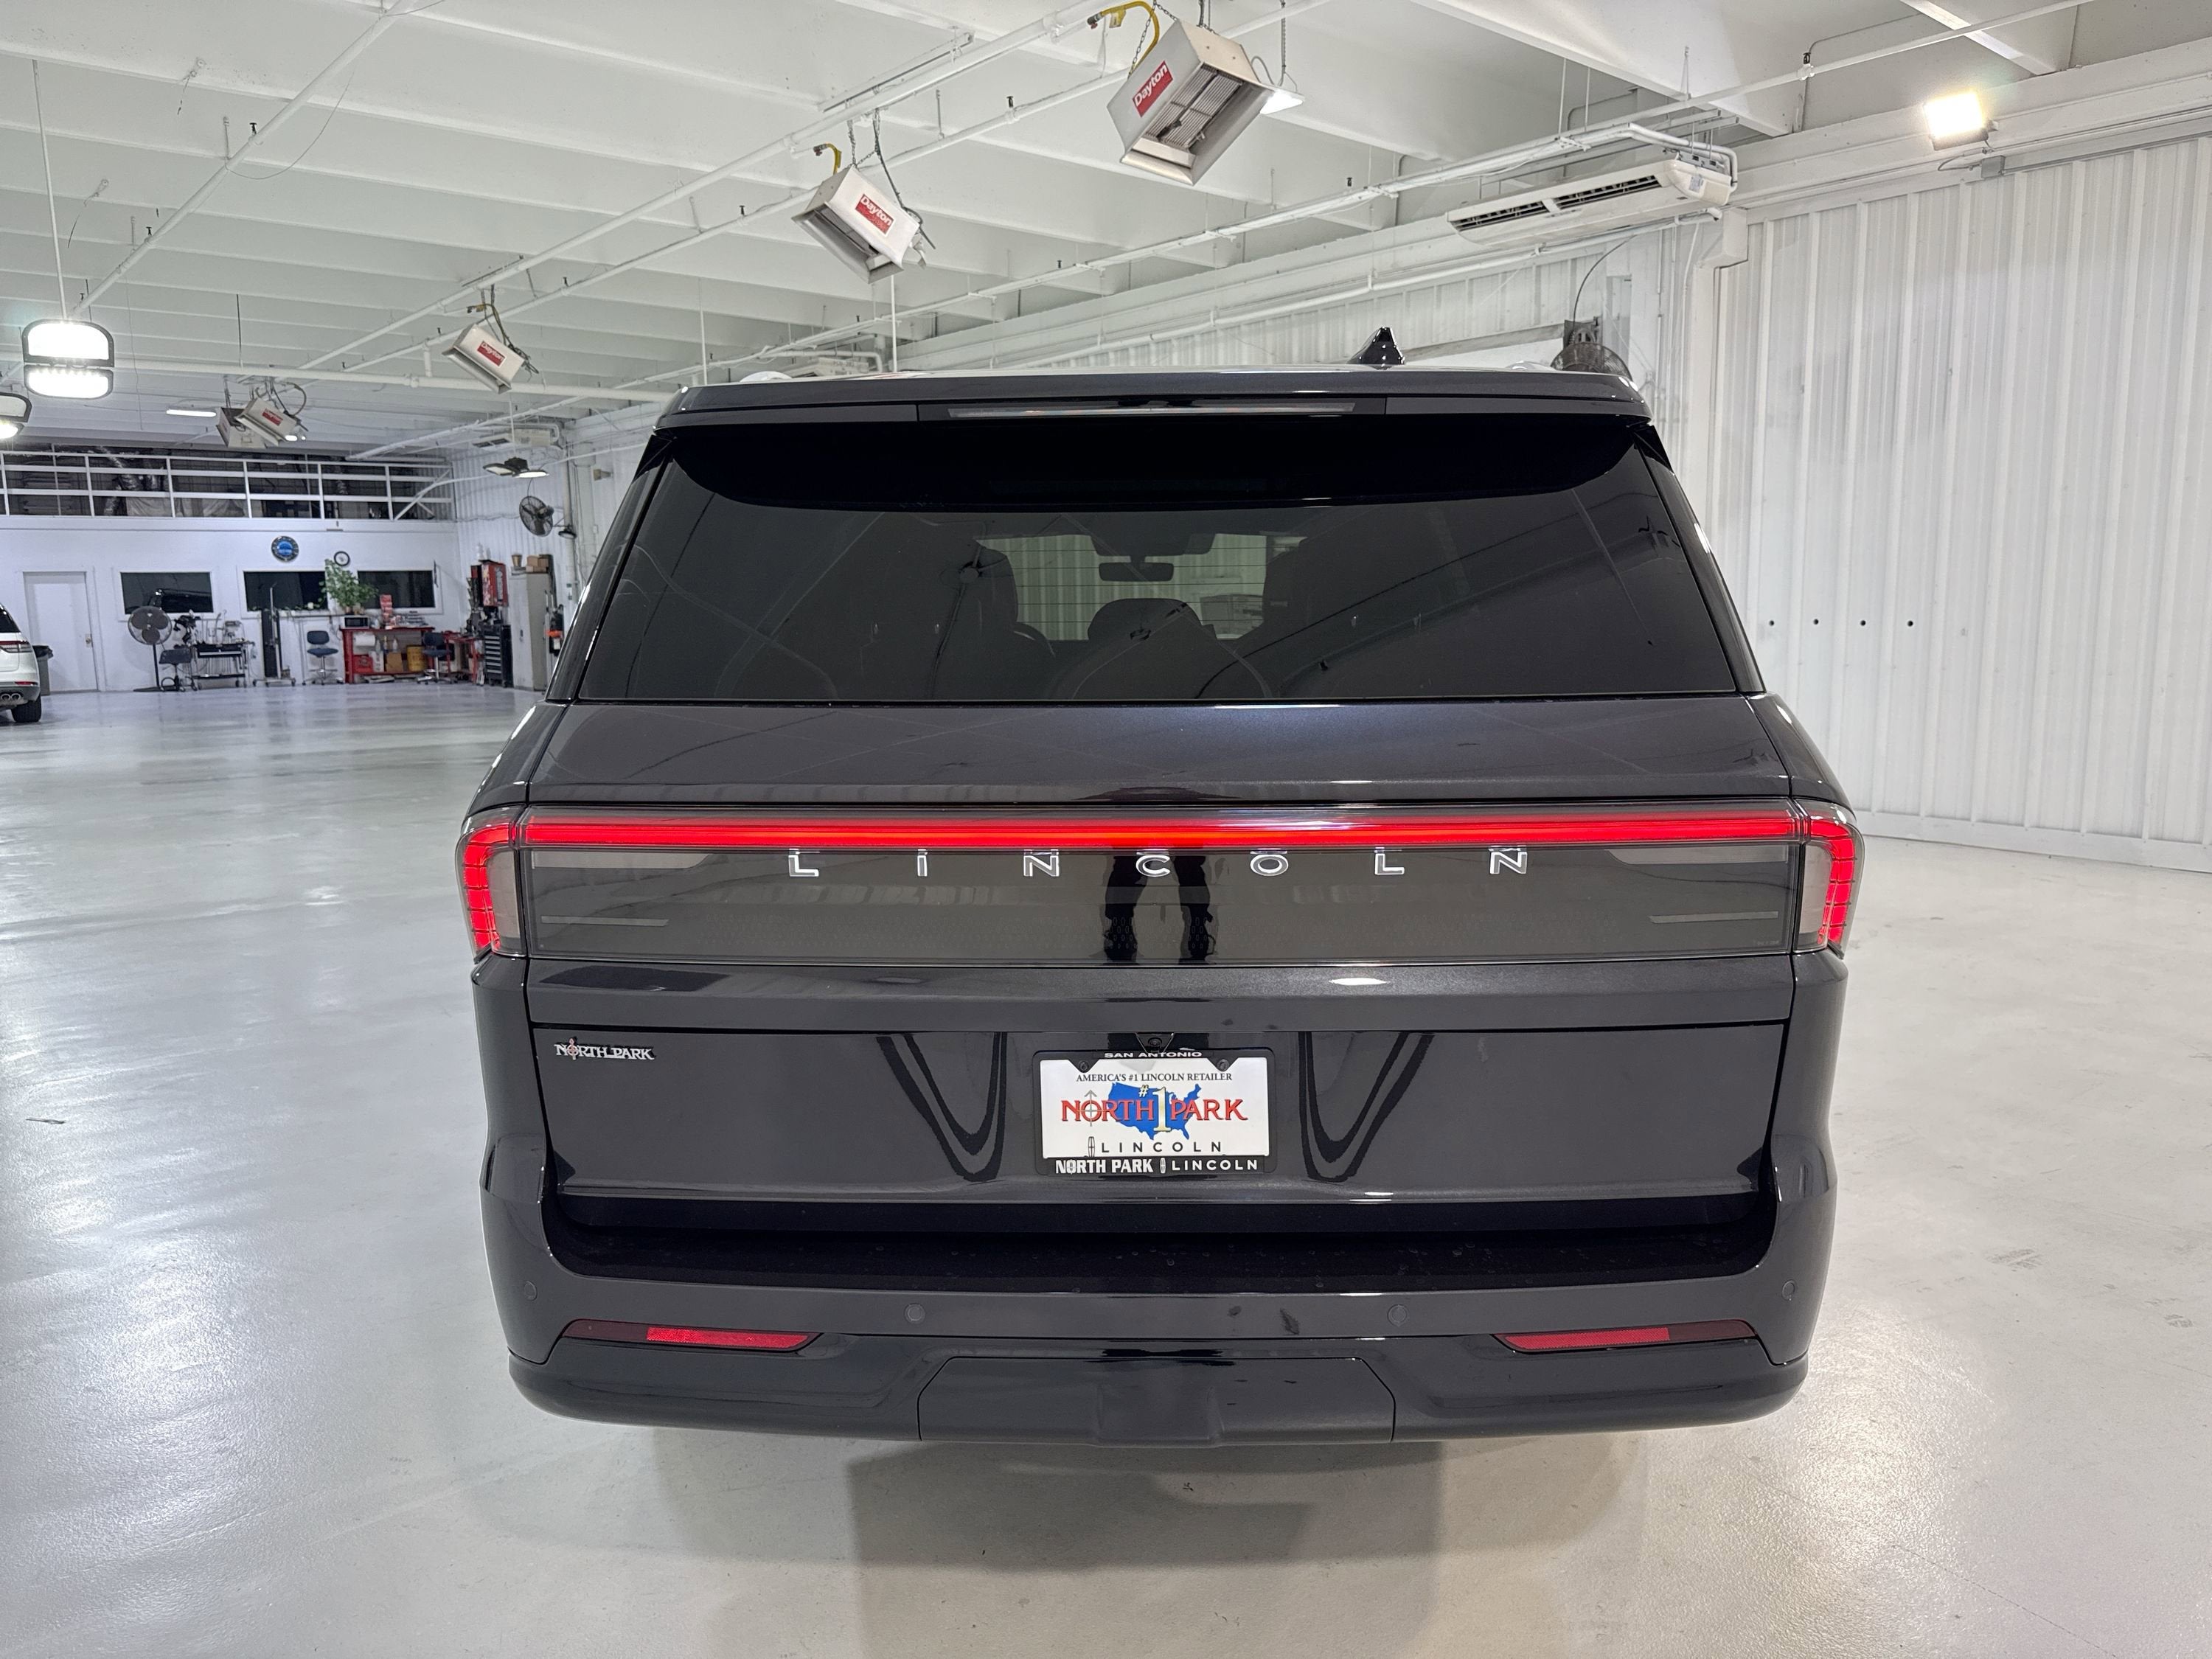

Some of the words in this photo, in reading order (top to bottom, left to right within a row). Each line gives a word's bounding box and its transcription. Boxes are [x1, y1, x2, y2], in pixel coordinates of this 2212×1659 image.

[1134, 64, 1168, 107] Dayton
[860, 196, 892, 226] Dayton
[788, 850, 1528, 877] LINCOLN
[554, 1042, 608, 1060] NORTH
[610, 1047, 655, 1060] PARK
[1077, 1074, 1127, 1082] AMERICA'S
[1129, 1074, 1138, 1082] #1
[1141, 1074, 1185, 1082] LINCOLN
[1187, 1074, 1233, 1082] RETAILER
[1061, 1099, 1154, 1121] NORTH
[1170, 1099, 1248, 1121] PARK
[1102, 1141, 1221, 1153] LINCOLN
[1056, 1159, 1106, 1174] NORTH
[1111, 1159, 1153, 1173] PARK
[1172, 1160, 1258, 1171] LINCOLN
